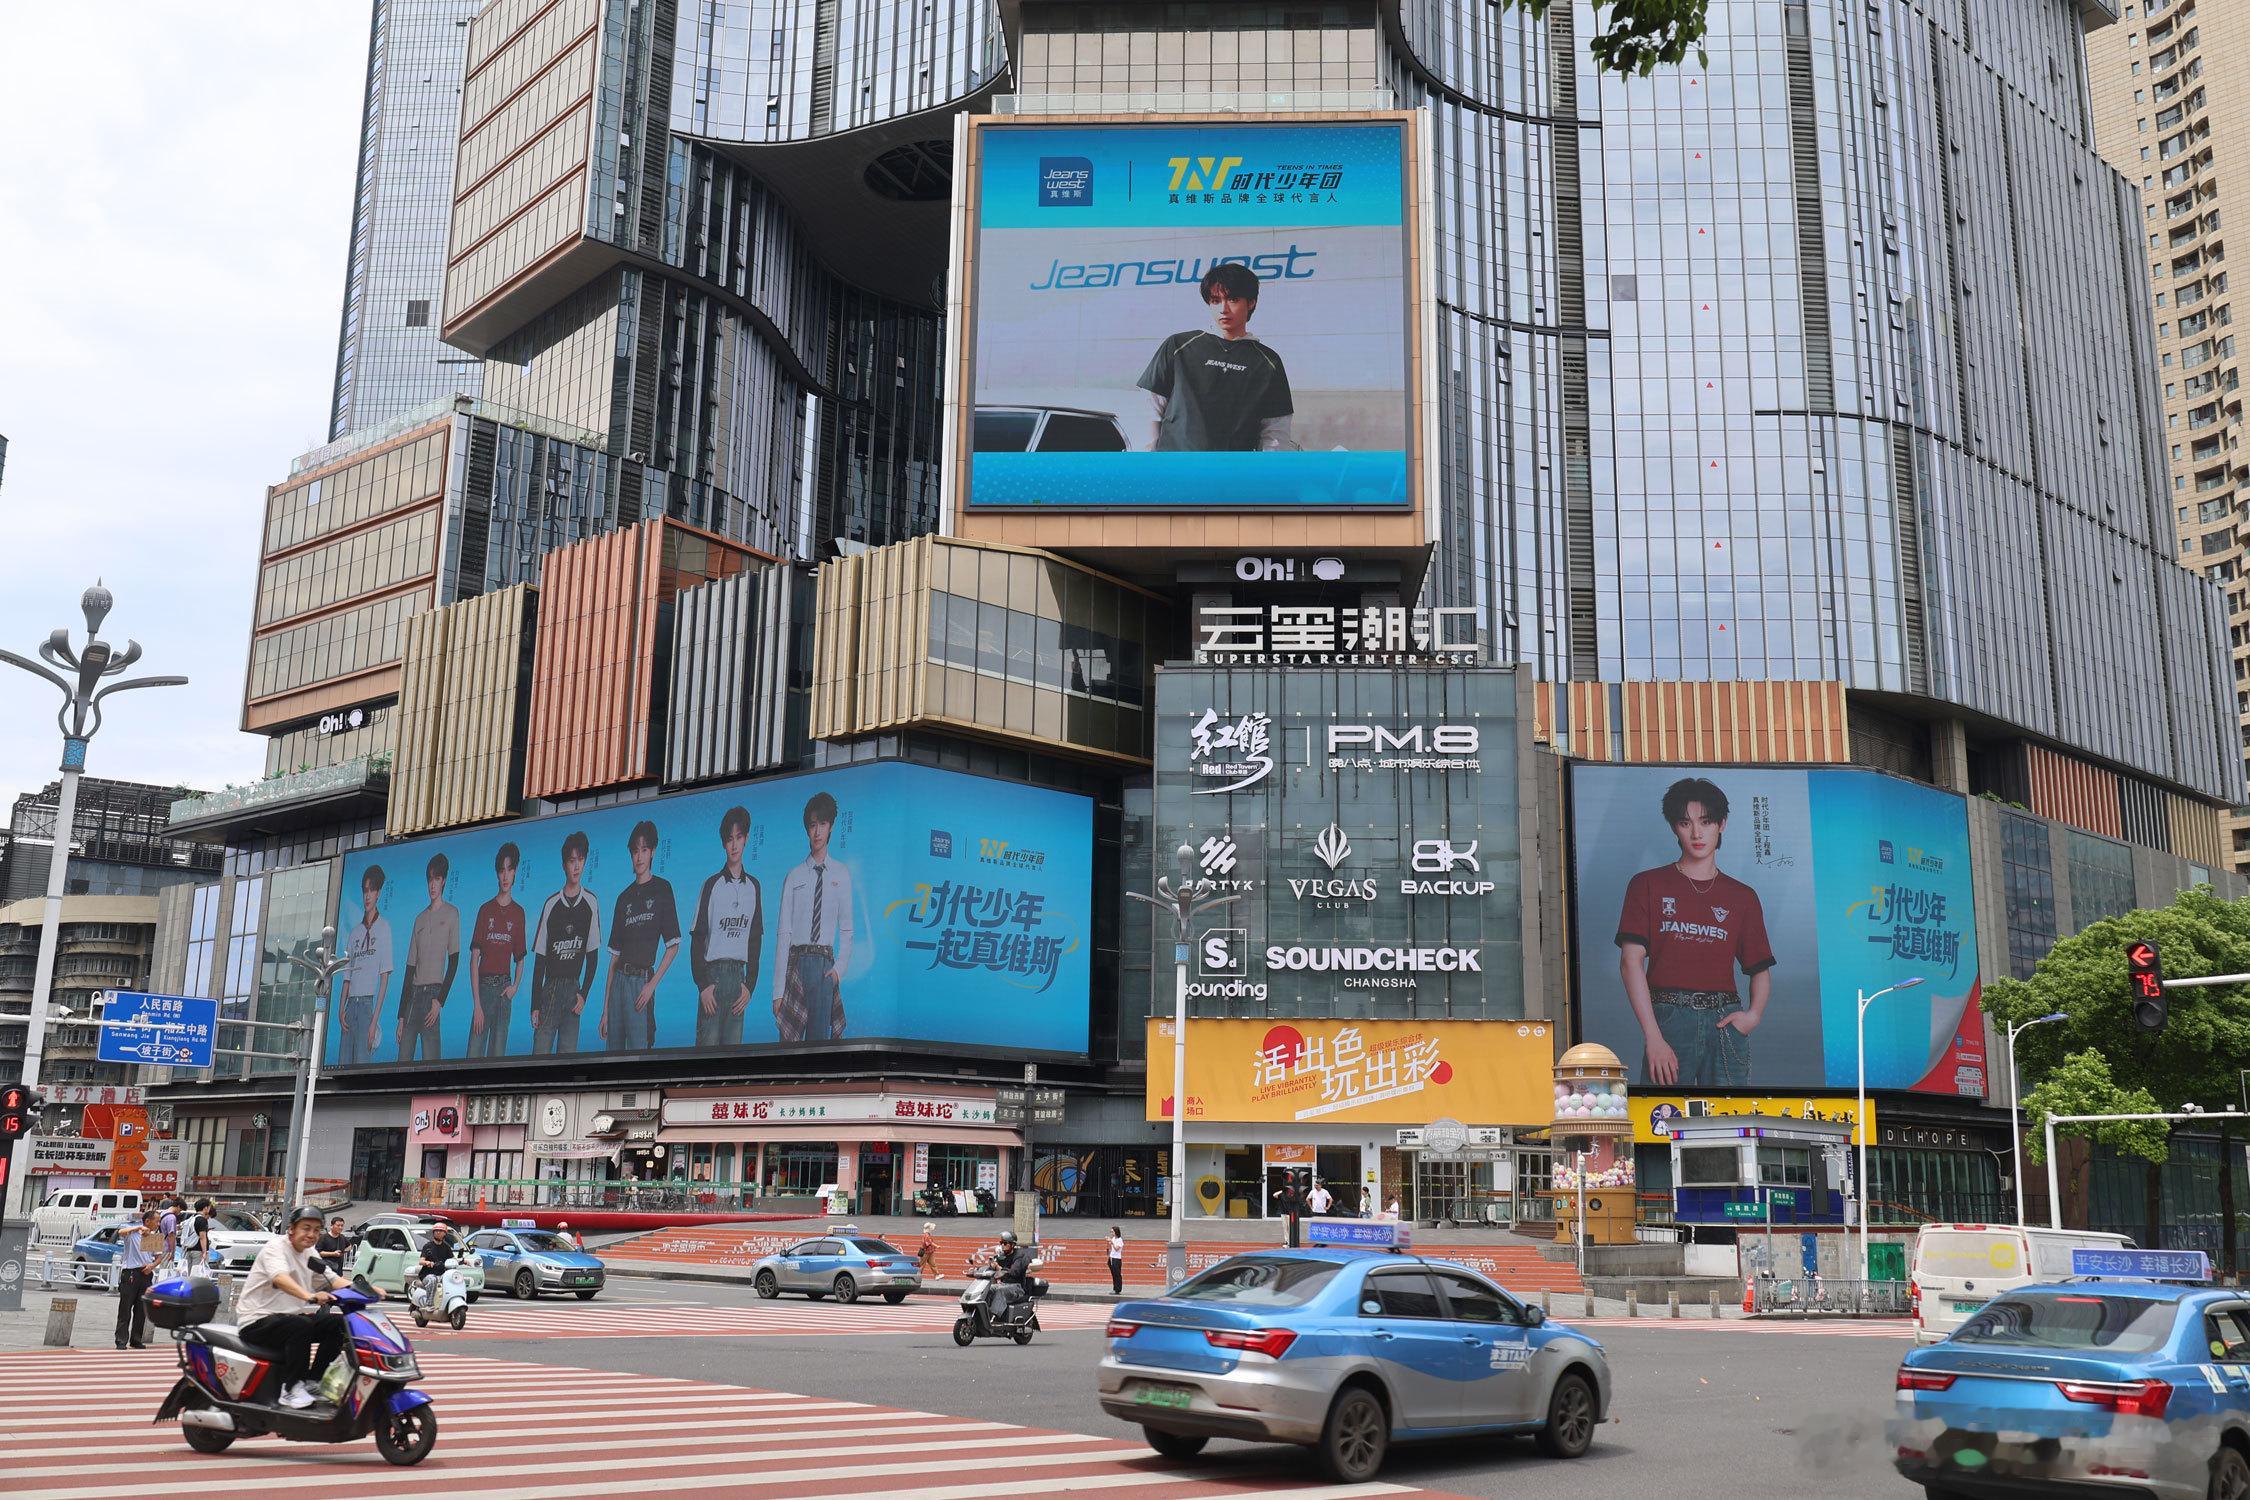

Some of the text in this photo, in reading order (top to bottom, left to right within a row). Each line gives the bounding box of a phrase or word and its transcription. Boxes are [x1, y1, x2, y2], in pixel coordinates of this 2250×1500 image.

[1043, 169, 1089, 179] Jeans
[1046, 178, 1085, 189] west
[1230, 172, 1344, 190] 时代少年团
[1050, 190, 1082, 199] 真维斯
[1168, 193, 1338, 204] 真维斯品牌全球代言人
[1205, 359, 1247, 371] JEANS WEST
[1236, 557, 1294, 581] Oh!
[1200, 605, 1478, 651] 云墨潮汇
[319, 712, 343, 734] Oh!
[1328, 725, 1479, 753] PM.8
[1202, 763, 1221, 775] Red
[1288, 878, 1377, 901] VEGAS
[1401, 880, 1495, 895] BACKUP
[908, 880, 1045, 932] 时代少年
[1868, 883, 1947, 927] 时代少年
[1660, 921, 1728, 941] JEANSWEST
[905, 928, 1066, 994] 一起真维斯
[1266, 946, 1482, 972] SOUNDCHECK
[1868, 924, 1960, 980] 一起真维斯
[1344, 978, 1417, 988] CHANGSHA
[140, 997, 183, 1012] 人民西路
[142, 1046, 171, 1057] 坡子街
[1253, 1027, 1366, 1087] 活出色
[1321, 1038, 1441, 1101] 玩出彩
[1251, 1081, 1317, 1102] PLAY BRILLIANTLY
[1260, 1074, 1317, 1094] LIVE VIBRANTLY
[6, 1118, 19, 1131] 15
[415, 1111, 428, 1126] Oh!
[122, 1125, 131, 1135] P
[1157, 1151, 1168, 1176] HAPPY
[2075, 1253, 2200, 1275] 平安长沙 幸福长沙
